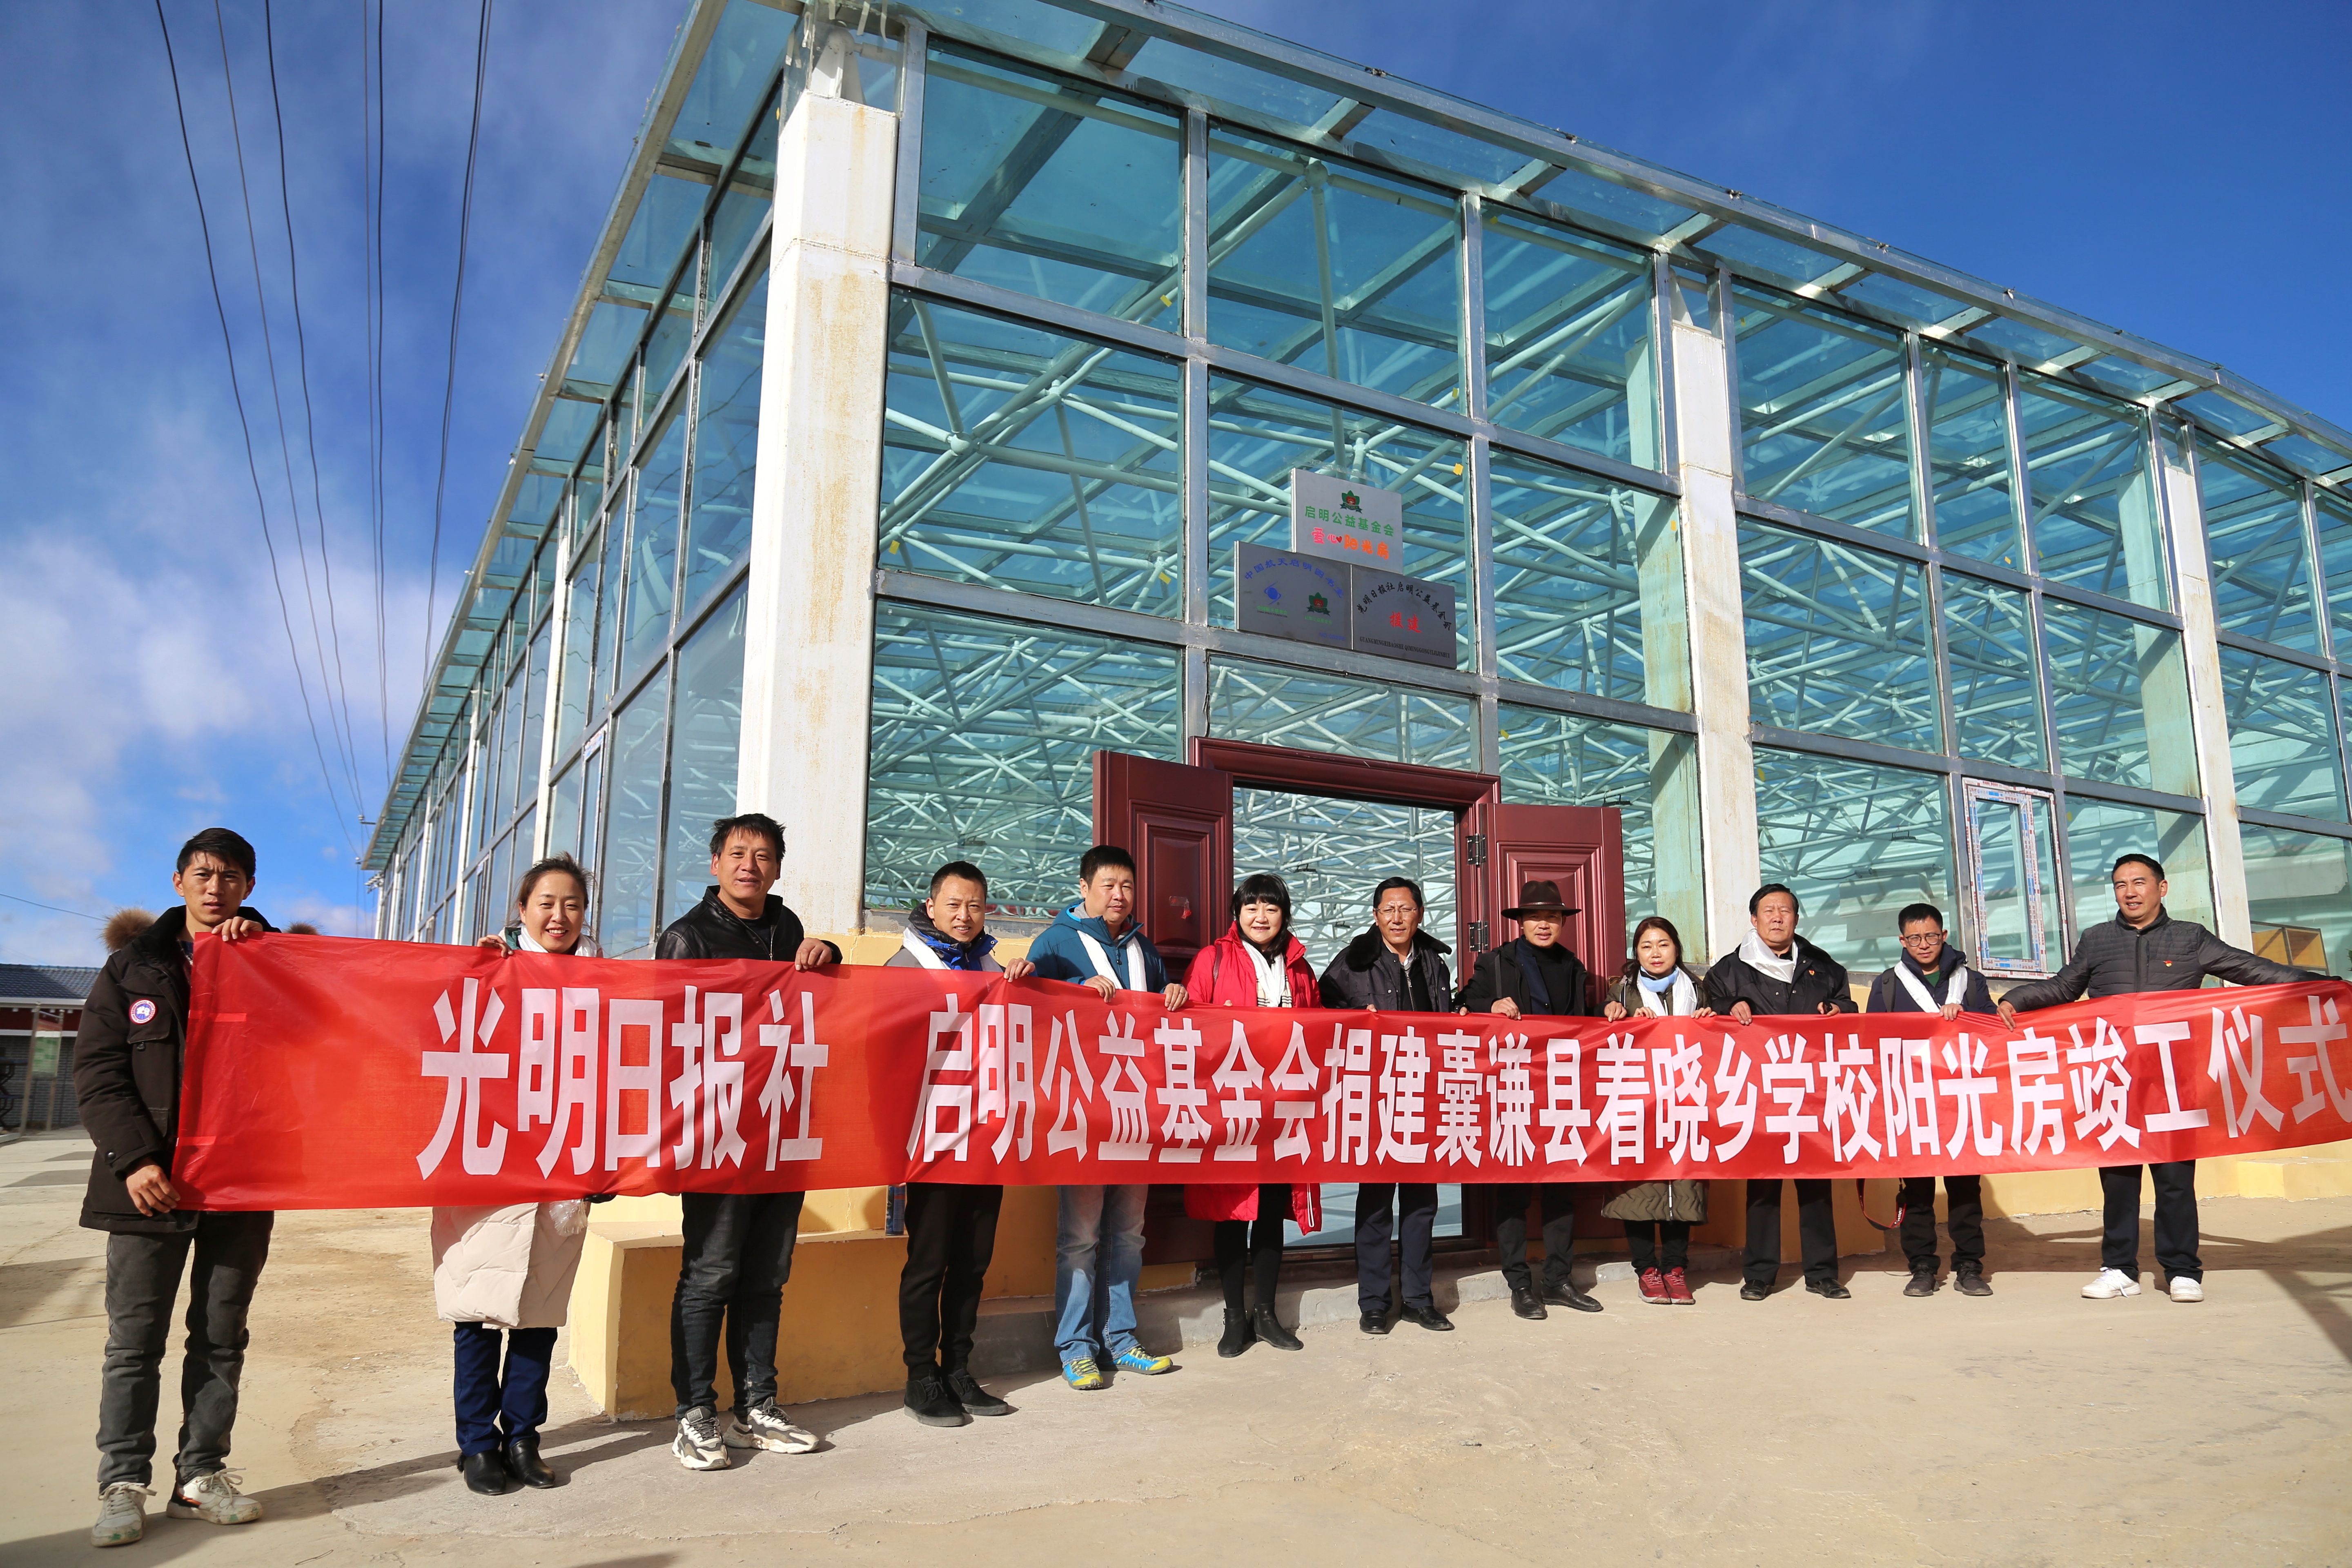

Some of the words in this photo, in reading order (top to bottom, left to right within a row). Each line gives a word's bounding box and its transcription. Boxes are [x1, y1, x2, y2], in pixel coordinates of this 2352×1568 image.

[1305, 506, 1394, 537] 启明公益基金会
[1356, 581, 1452, 630] 光明日报社启明公益基金会
[1389, 611, 1422, 633] 援建
[1360, 636, 1404, 650] GUANGMINGRIBAOSHE
[416, 978, 828, 1180] 光明日报社
[906, 993, 2352, 1167] 启明公益基金会捐建囊谦县着晓乡学校阳光房竣工仪式
